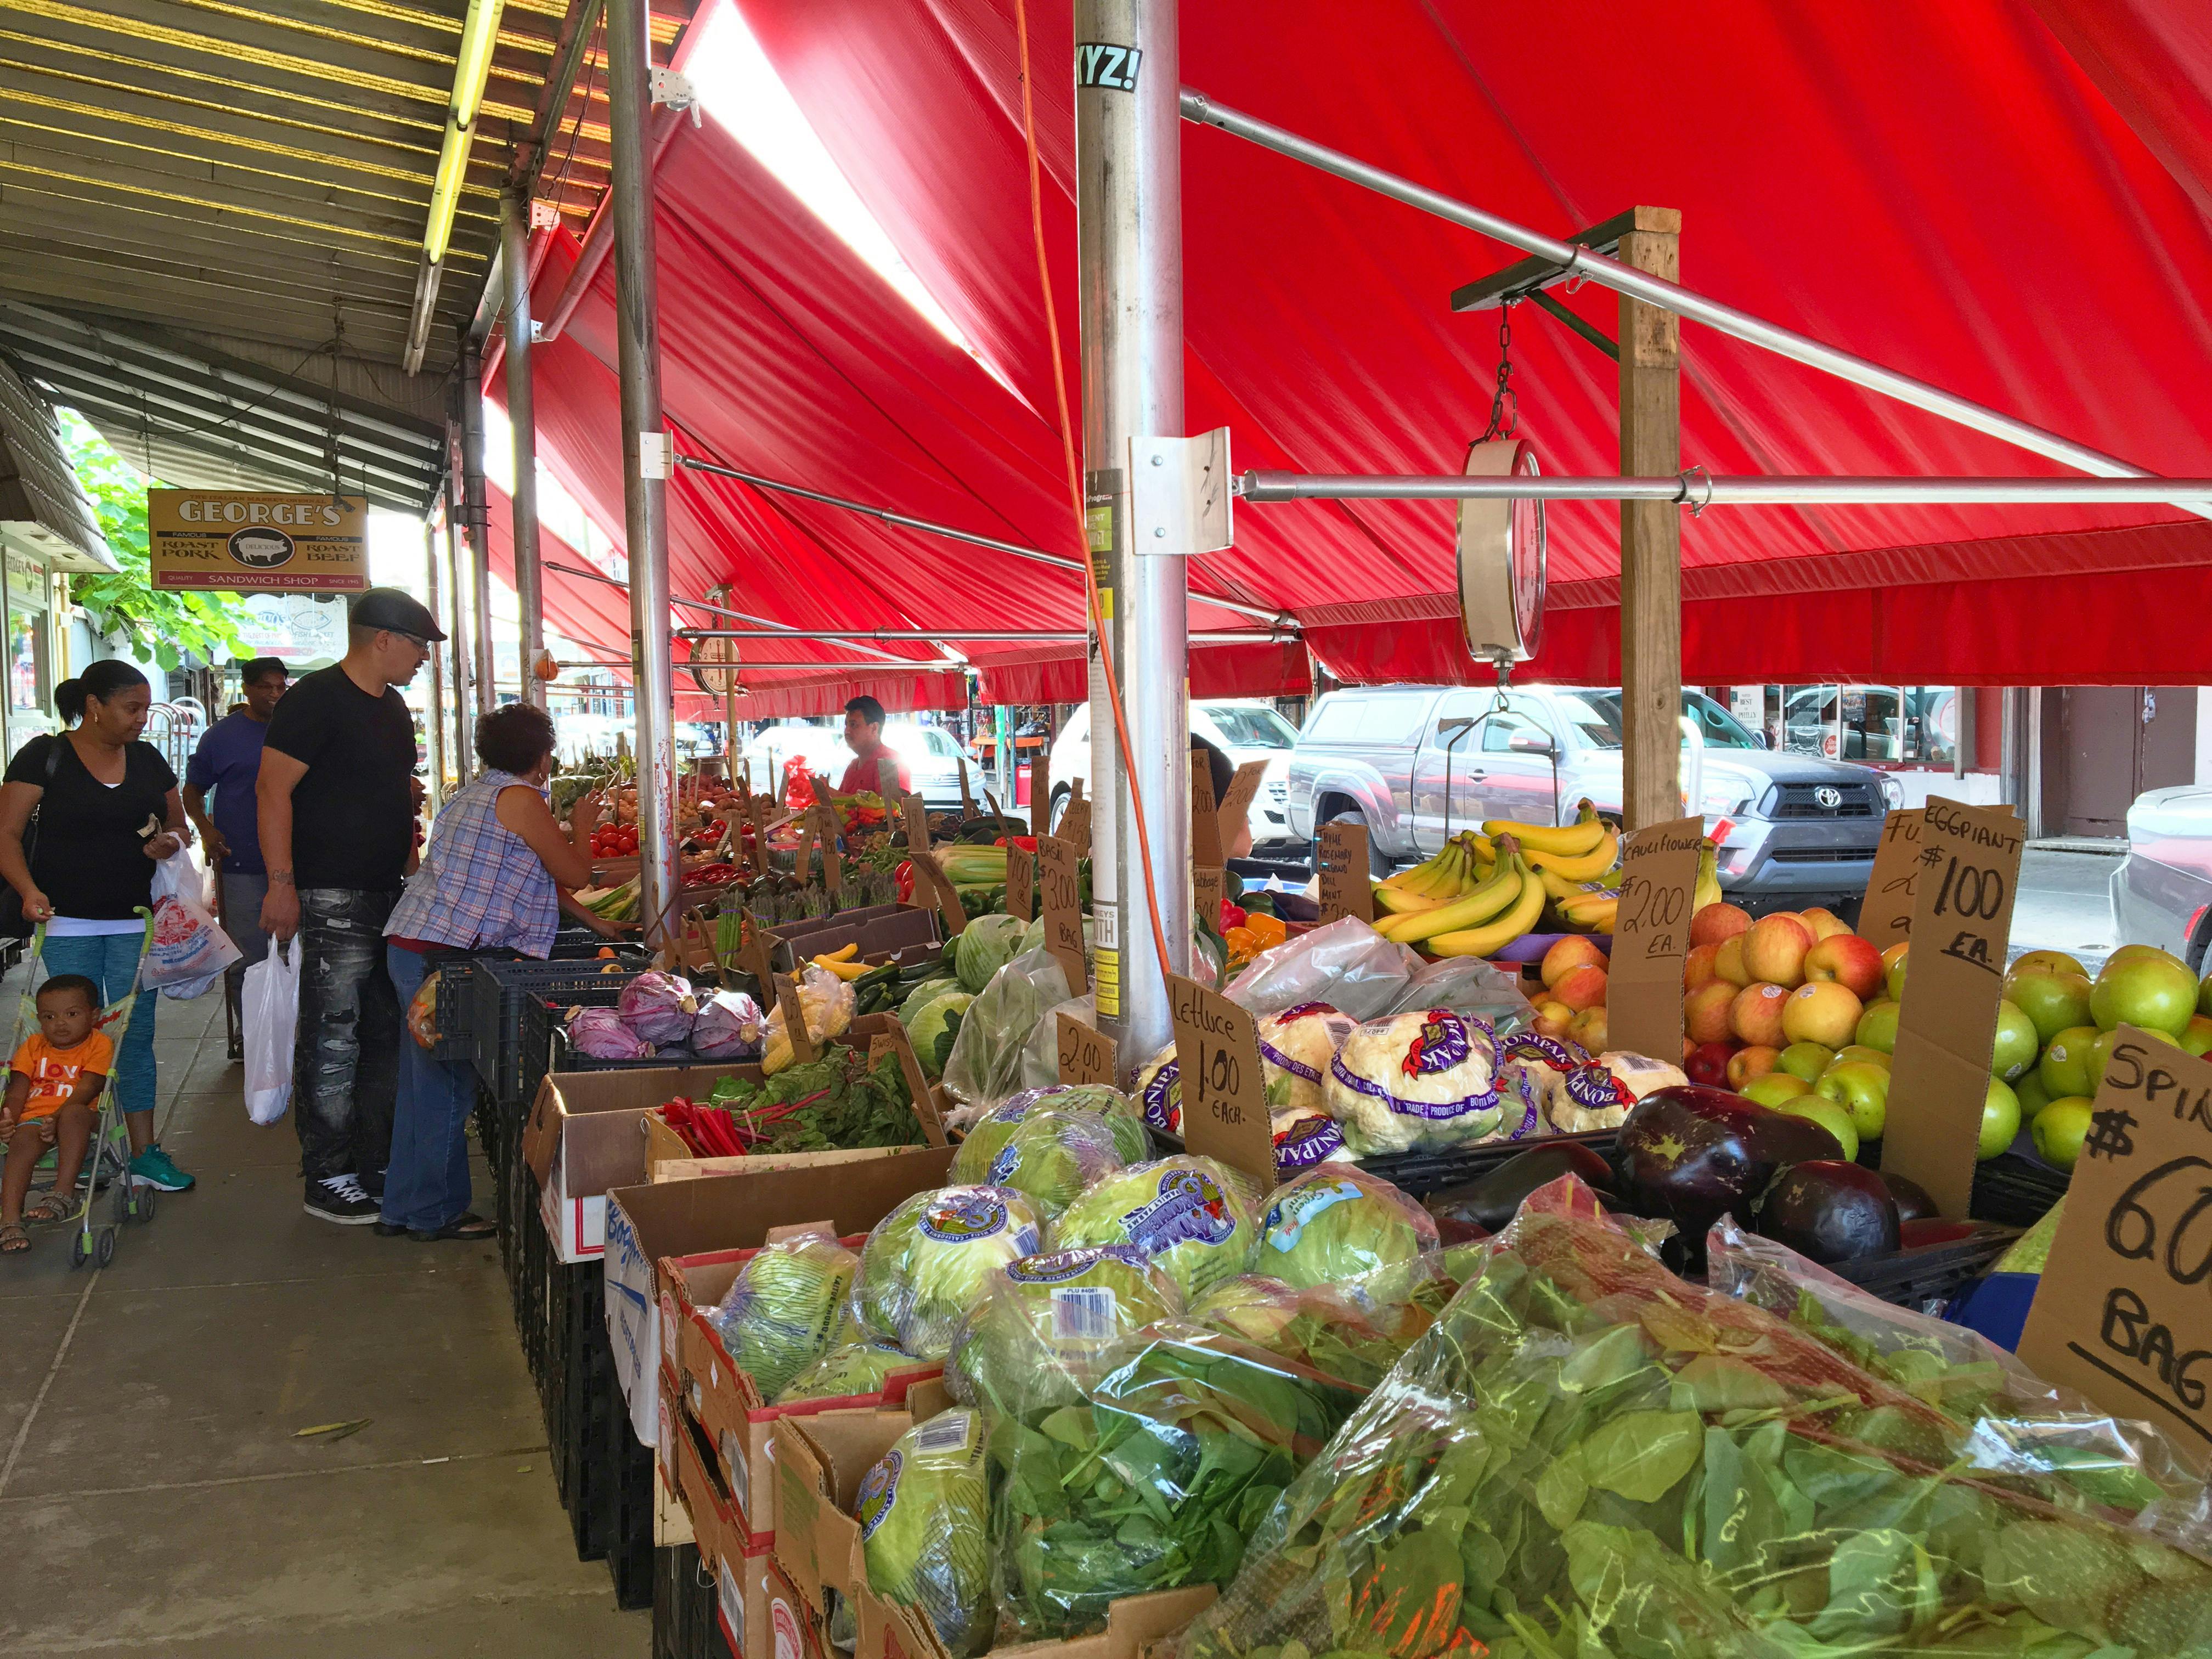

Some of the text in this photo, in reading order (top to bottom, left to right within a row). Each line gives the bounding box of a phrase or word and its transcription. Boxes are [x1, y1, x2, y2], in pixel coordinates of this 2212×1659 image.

[178, 500, 341, 526] GEORGE'S
[162, 540, 219, 549] ROAST
[162, 549, 223, 560] PORK
[307, 545, 360, 553] ROAST
[307, 553, 360, 562] BEEF
[208, 575, 282, 584] SANDWICH
[284, 577, 318, 585] SHOP
[1316, 828, 1342, 848] THYME
[1886, 814, 1921, 843] FU
[1319, 845, 1352, 864] ROSEMARY
[1321, 874, 1336, 887] DILL
[1321, 888, 1342, 900] MINT
[1095, 910, 1115, 918] NEYS
[1059, 922, 1078, 949] BAG
[1647, 933, 1676, 953] EA.
[1060, 1026, 1101, 1073] 2.00
[1198, 1040, 1239, 1103] 1.00
[1153, 1064, 1180, 1128] BONIPA
[1405, 1103, 1425, 1114] RADE
[1430, 1104, 1455, 1116] PRODUCE
[1455, 1103, 1465, 1113] OF
[1130, 1177, 1211, 1244] BROTHERS
[1150, 1189, 1181, 1215] FAMILY
[1126, 1204, 1153, 1229] FARMS
[1152, 1206, 1214, 1255] ADAM
[2101, 1287, 2212, 1409] BAG
